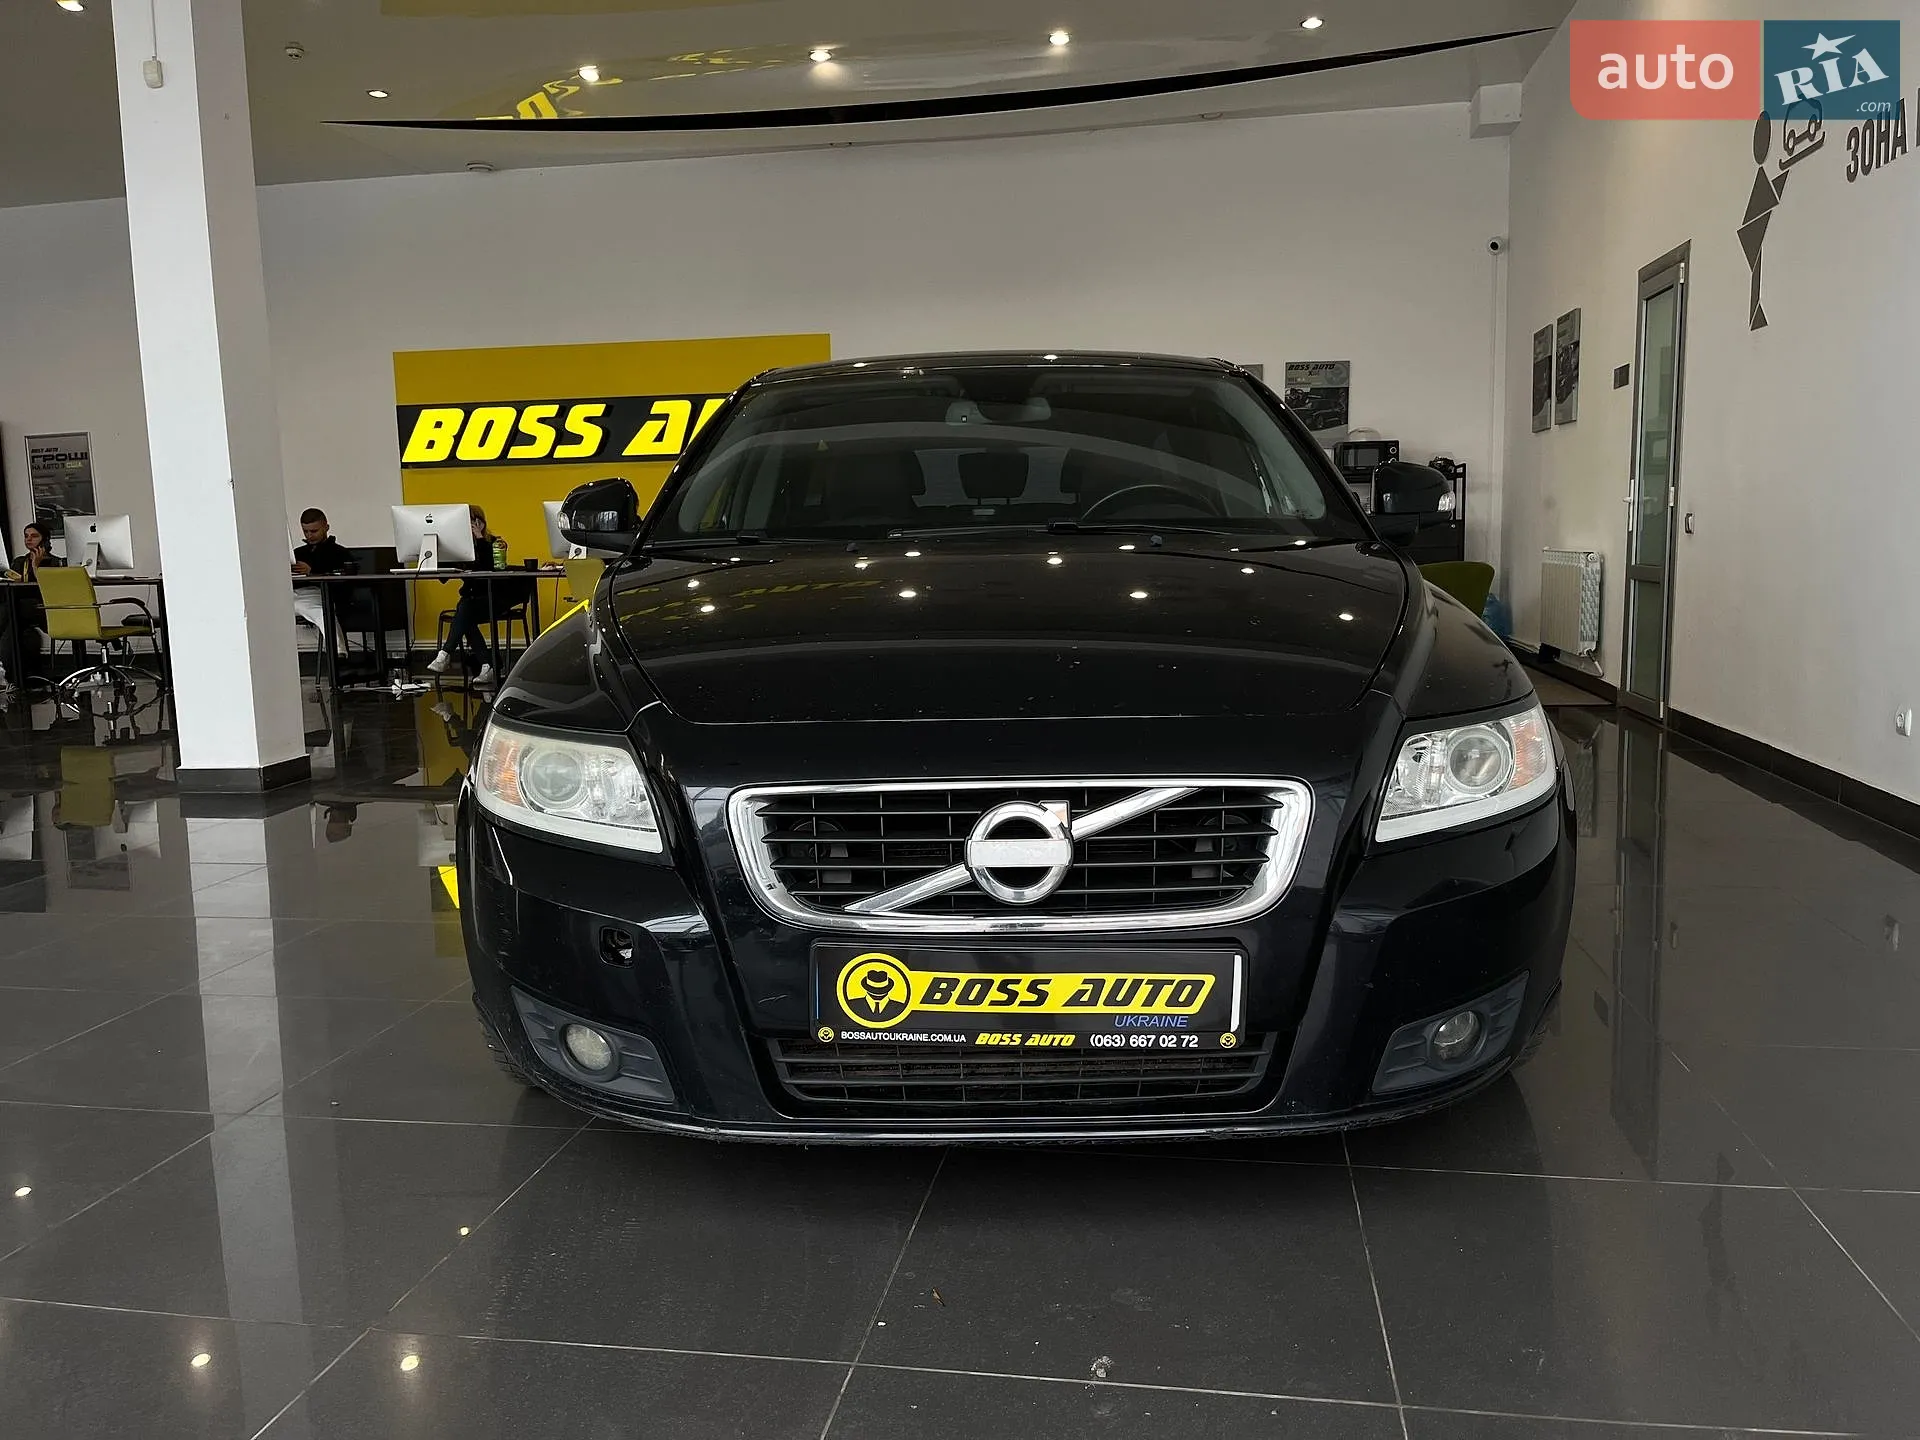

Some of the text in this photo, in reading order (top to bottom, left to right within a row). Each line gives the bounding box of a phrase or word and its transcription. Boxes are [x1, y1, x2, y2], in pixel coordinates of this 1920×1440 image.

[1846, 98, 1908, 183] ЗОНА
[1287, 363, 1310, 371] BOSS
[401, 404, 606, 463] BOSS
[920, 976, 1205, 1008] BOSS AUTO
[1113, 1015, 1189, 1028] UKRAINE
[840, 1030, 1198, 1048] BOSSAUTOUKRAINE.COM.UA BOSS AUTO (063) 667 02 72
